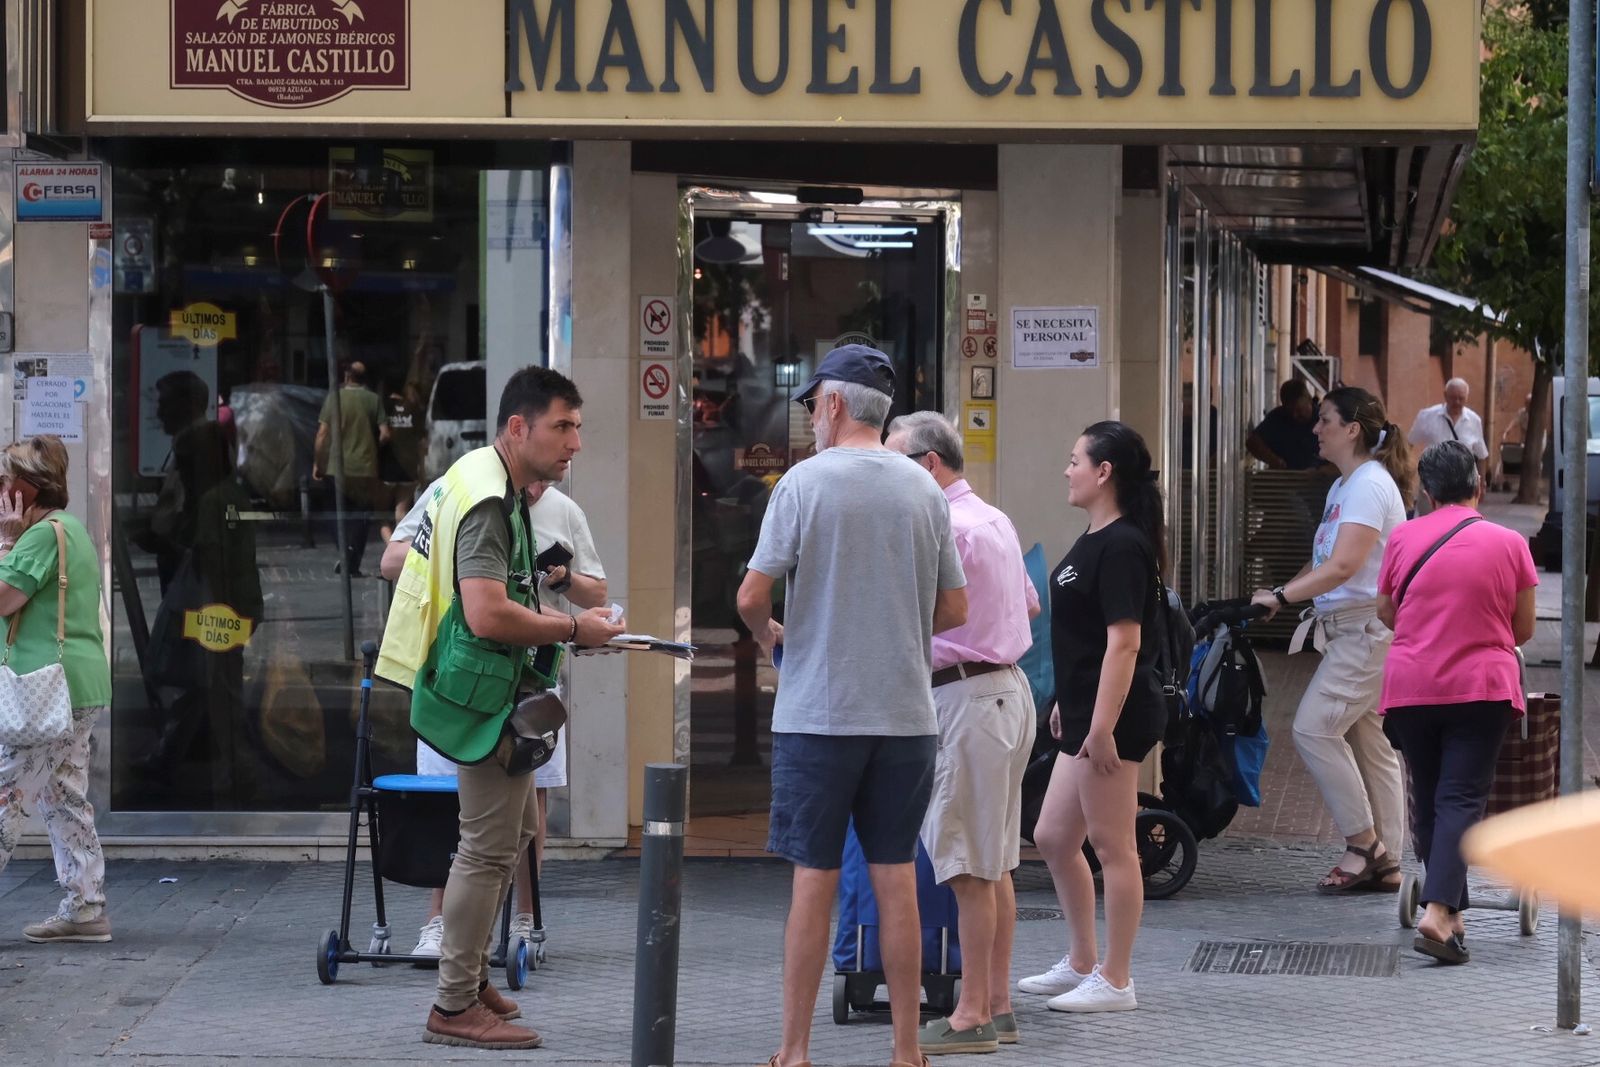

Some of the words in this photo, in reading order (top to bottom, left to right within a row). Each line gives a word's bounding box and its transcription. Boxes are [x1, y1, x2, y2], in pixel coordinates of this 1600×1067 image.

[260, 2, 316, 16] FÁBRICA
[240, 18, 258, 30] DE
[262, 18, 339, 30] EMBUTIDOS
[185, 31, 246, 44] SALAZÓN
[249, 33, 267, 44] DE
[270, 33, 331, 44] JAMONES
[335, 31, 395, 44] IBÉRICOS
[505, 0, 921, 95] MANUEL
[958, 0, 1432, 99] CASTILLO
[186, 49, 280, 72] MANUEL
[287, 49, 395, 73] CASTILLO
[20, 168, 54, 176] ALARMA
[69, 168, 98, 176] HORAS
[44, 185, 95, 199] FERSA
[1016, 320, 1030, 328] SE
[1034, 319, 1092, 328] NECESITA
[1024, 332, 1087, 342] PERSONAL
[196, 612, 241, 630] ÚLTIMOS
[206, 629, 230, 644] DÍAS
